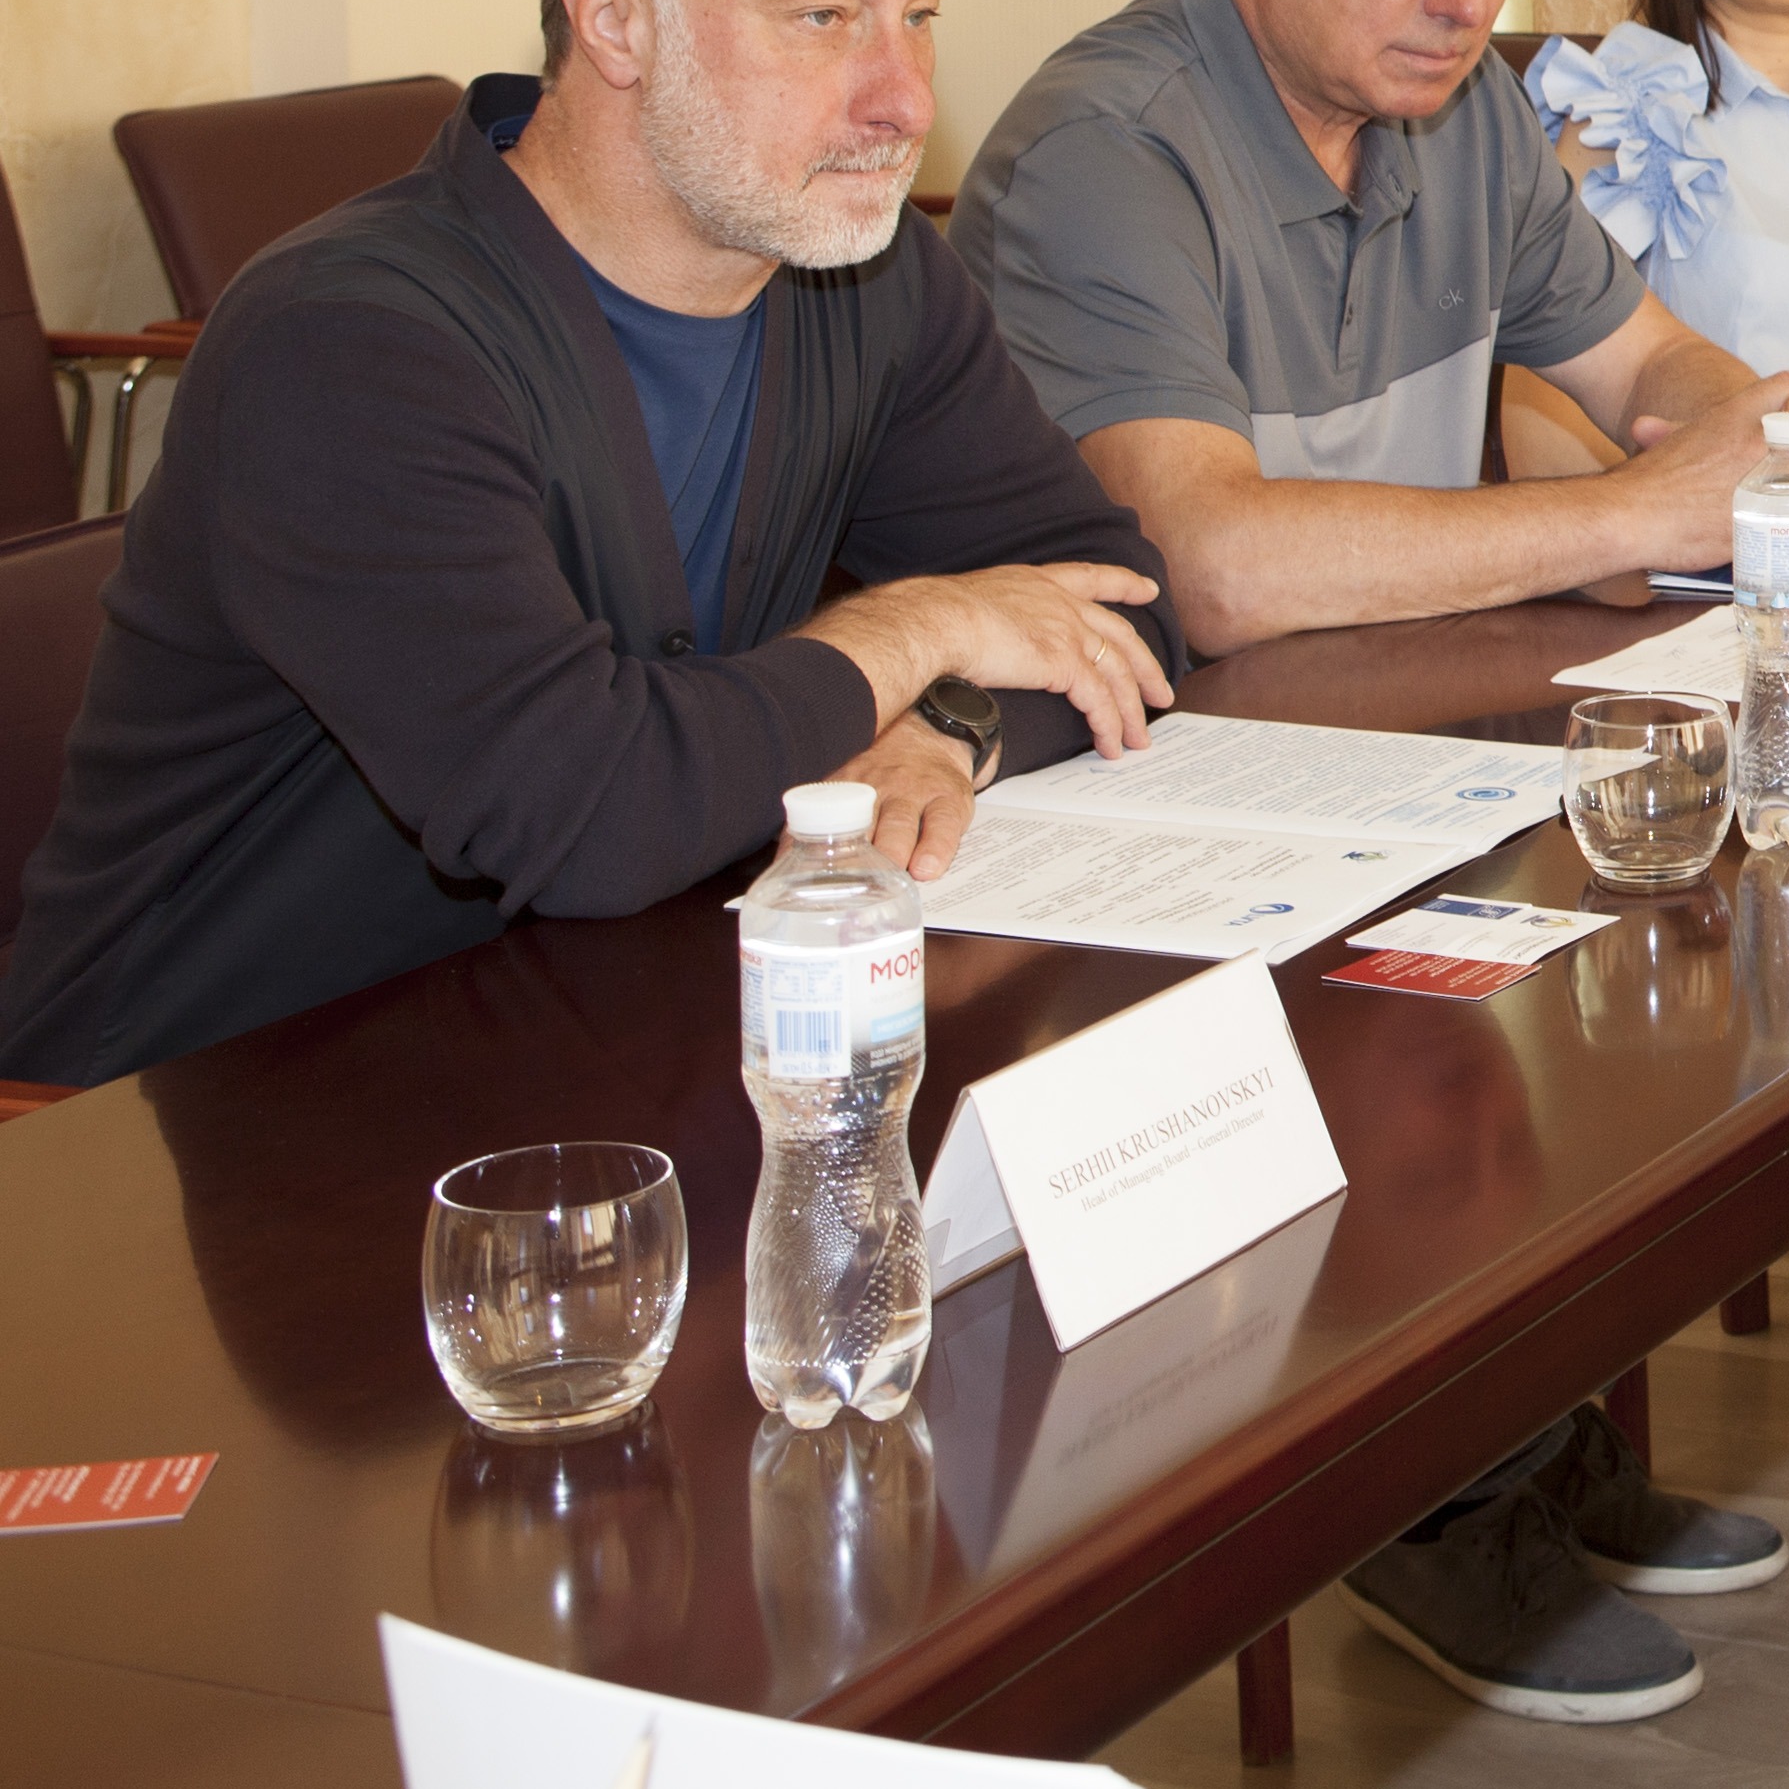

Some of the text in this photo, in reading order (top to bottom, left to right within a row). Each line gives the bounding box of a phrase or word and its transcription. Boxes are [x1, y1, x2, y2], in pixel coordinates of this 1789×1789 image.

[871, 947, 924, 984] мор
[1048, 1066, 1275, 1200] SERHII KRUSHANOVSKYI
[1081, 1189, 1107, 1212] Head
[1107, 1181, 1120, 1199] of
[1118, 1161, 1166, 1192] Managing
[1163, 1145, 1192, 1170] Board
[1197, 1127, 1232, 1151] General
[1231, 1108, 1266, 1135] Director
